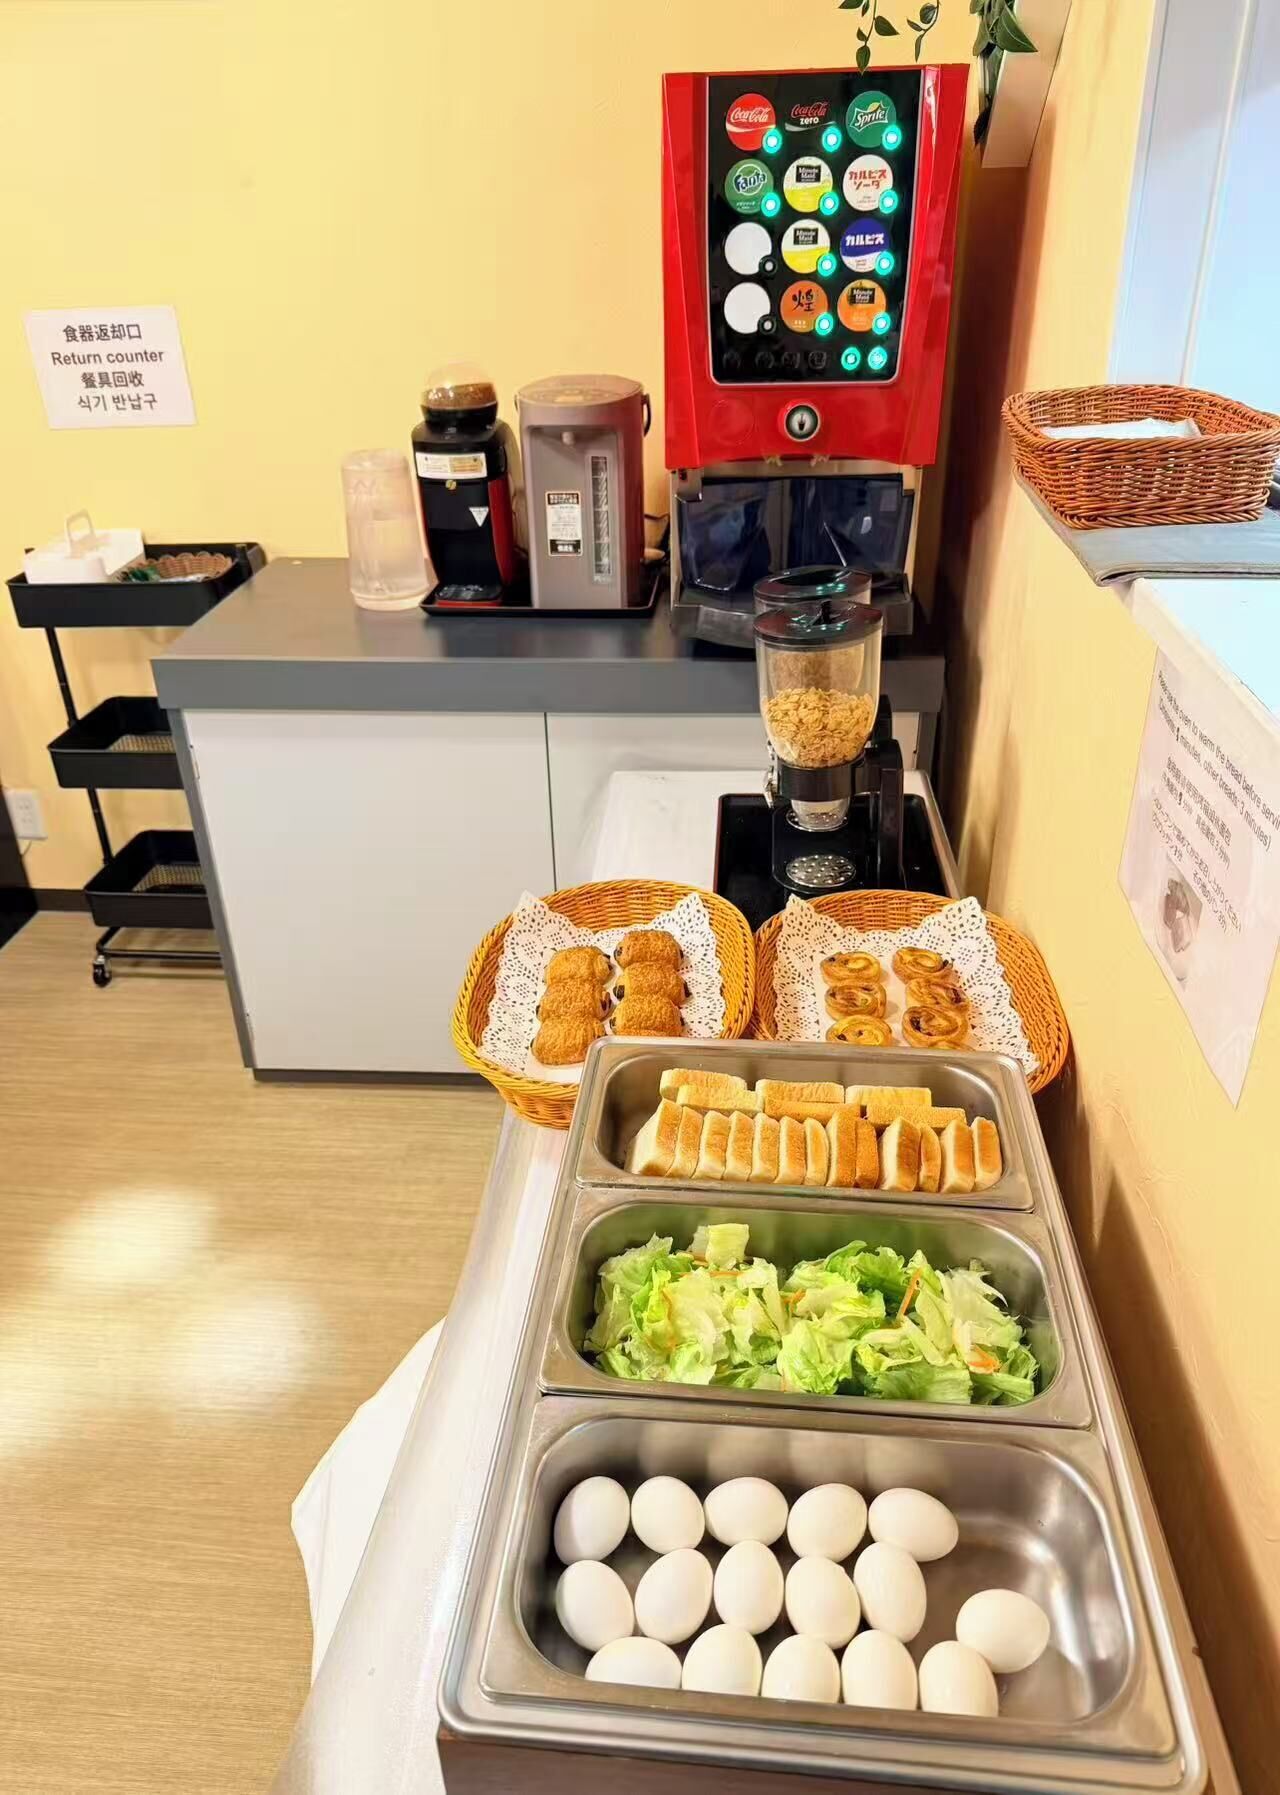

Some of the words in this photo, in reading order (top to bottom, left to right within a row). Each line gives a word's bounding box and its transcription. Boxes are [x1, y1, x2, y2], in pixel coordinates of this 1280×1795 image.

[731, 107, 771, 123] Coca-Cola
[791, 101, 829, 118] Coca-Cola
[856, 108, 885, 127] Sprite
[800, 117, 819, 125] zero
[734, 171, 766, 192] Fanta
[848, 169, 887, 180] カルピス
[854, 180, 880, 191] ソーダ
[845, 233, 885, 246] カルピス
[63, 323, 142, 343] 食器返却口
[51, 351, 103, 366] Return
[107, 350, 164, 364] counter
[81, 371, 145, 389] 餐具回收
[78, 394, 108, 413] 식기
[113, 392, 158, 411] 반납구
[1191, 721, 1198, 735] to
[1198, 729, 1215, 753] warm
[1216, 744, 1226, 764] the
[1226, 756, 1243, 784] bread
[1242, 776, 1261, 808] before
[1203, 760, 1219, 784] other
[1239, 802, 1245, 815] 3
[1244, 810, 1272, 853] minutes)
